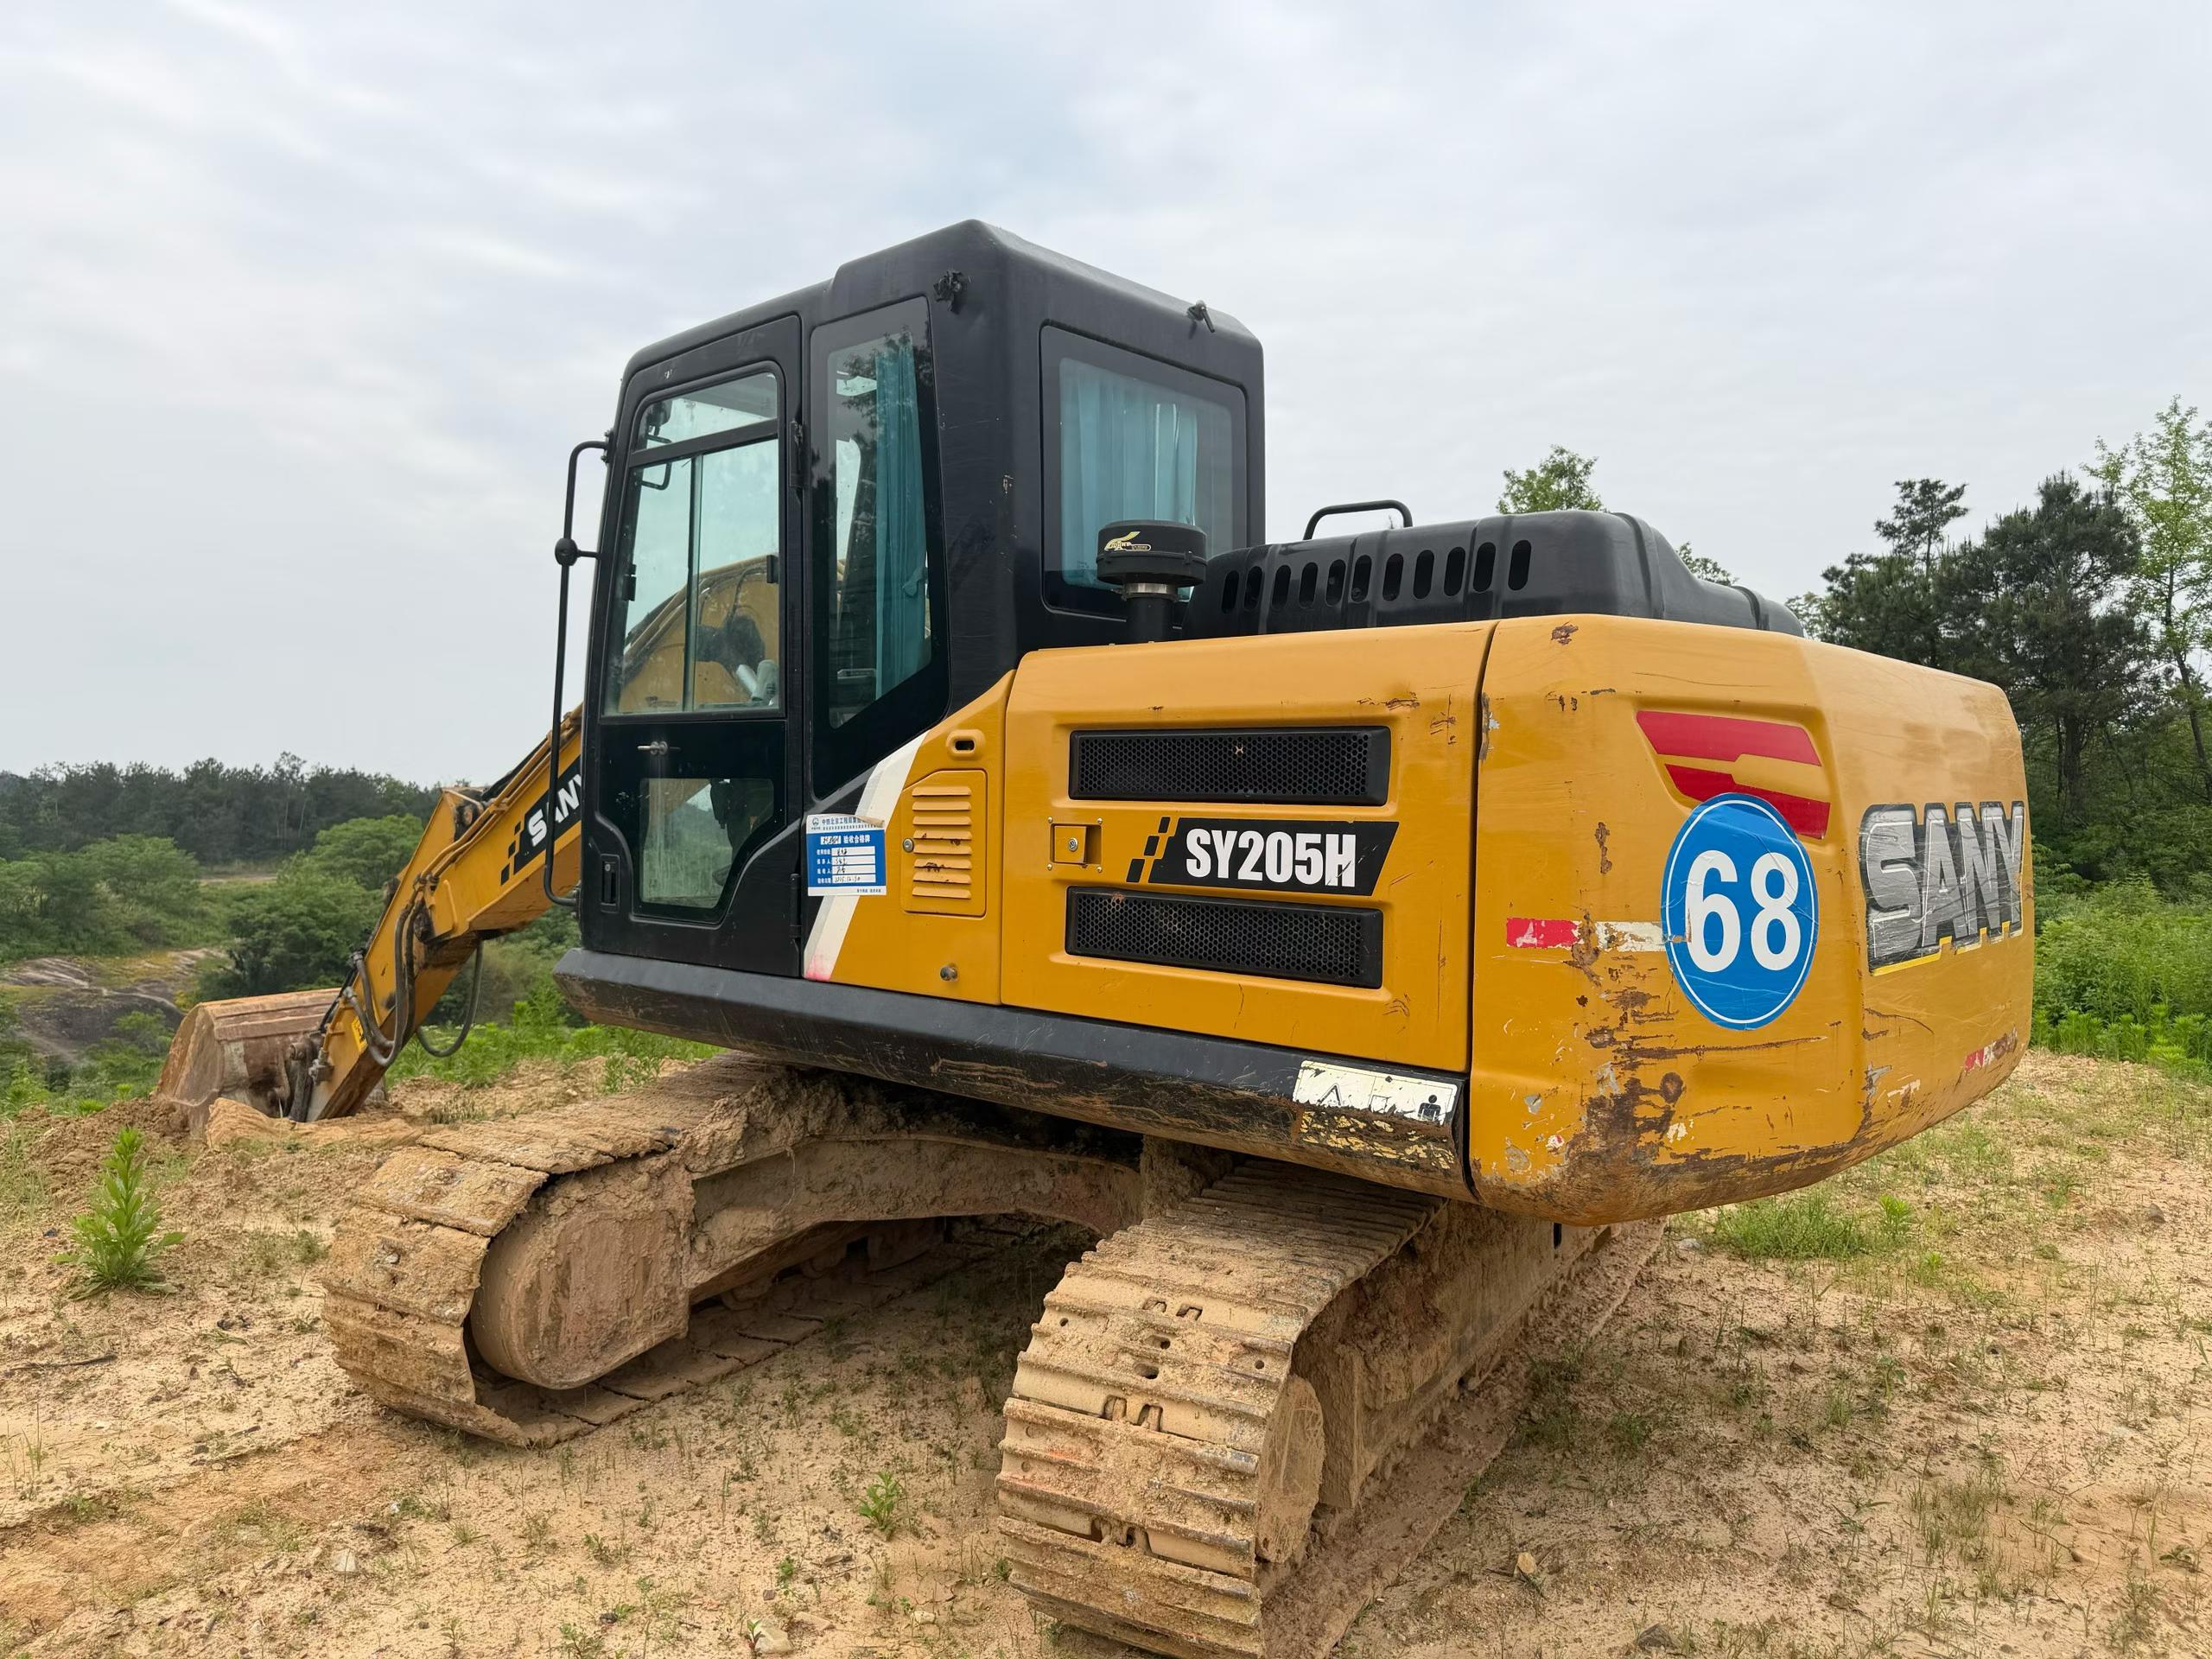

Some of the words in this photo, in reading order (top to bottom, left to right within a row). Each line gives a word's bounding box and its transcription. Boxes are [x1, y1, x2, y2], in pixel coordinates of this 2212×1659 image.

[528, 774, 582, 847] SN
[1185, 828, 1357, 887] SY205H
[1684, 849, 1802, 973] 68
[1859, 801, 2024, 971] SANY
